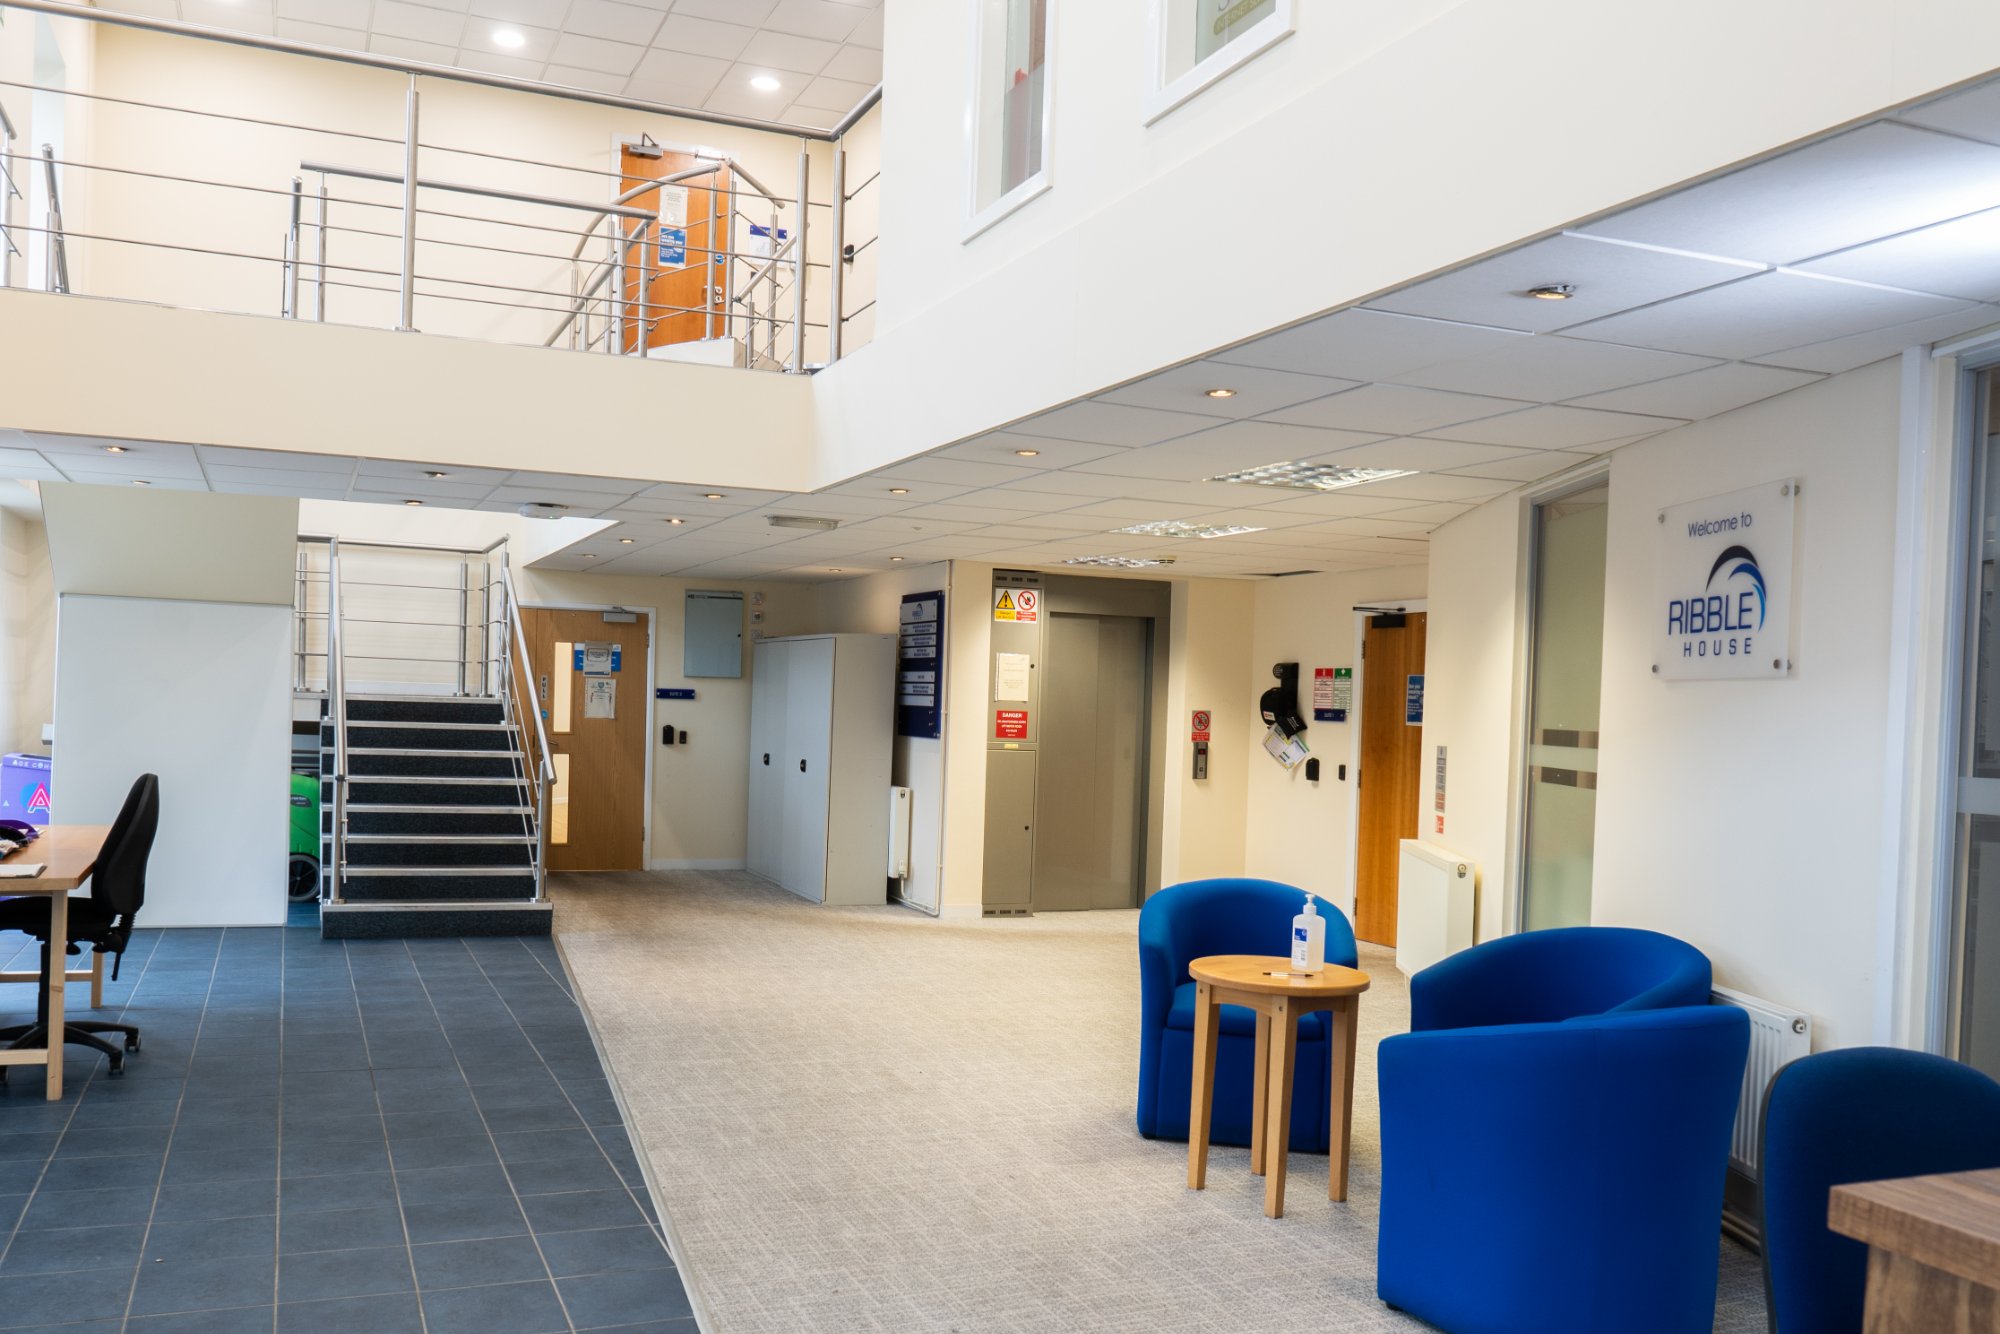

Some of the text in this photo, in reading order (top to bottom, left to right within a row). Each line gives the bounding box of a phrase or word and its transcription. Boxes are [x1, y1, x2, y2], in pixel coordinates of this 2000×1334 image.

[1688, 511, 1752, 538] Welcome to
[1668, 592, 1754, 636] RIBBLE
[1683, 638, 1752, 658] HOUSE
